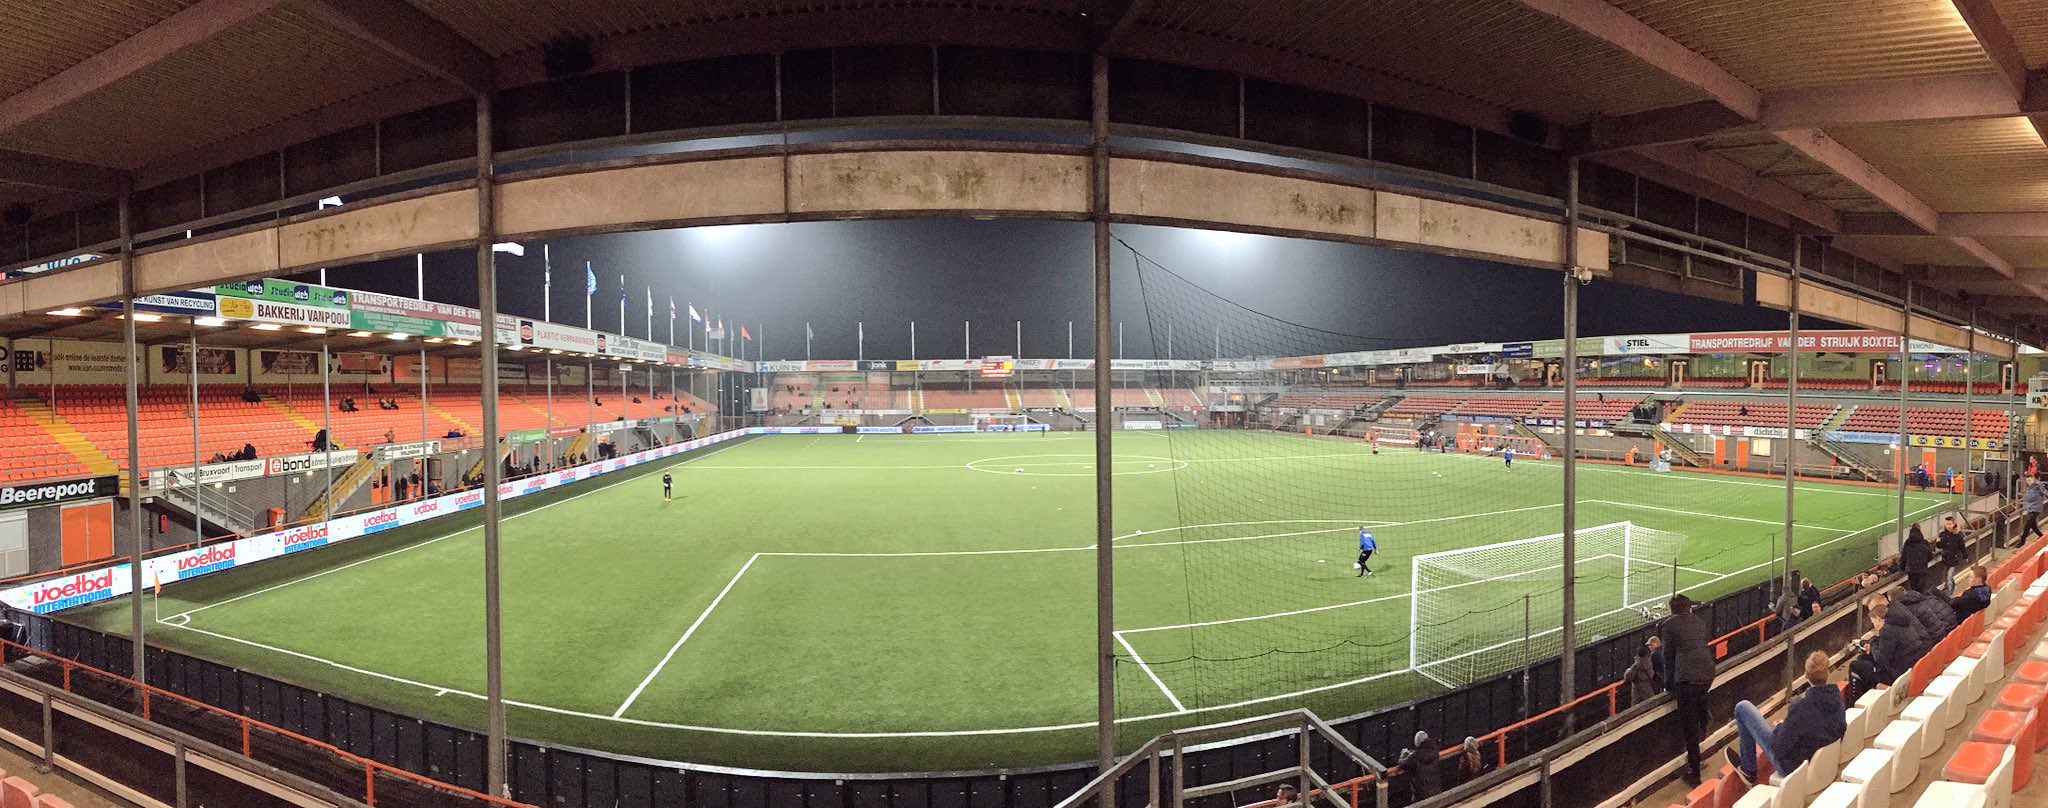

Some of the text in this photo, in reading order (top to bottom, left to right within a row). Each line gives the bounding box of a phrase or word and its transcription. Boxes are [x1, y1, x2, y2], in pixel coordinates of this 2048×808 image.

[144, 295, 165, 304] KUNST
[166, 297, 180, 305] VAN
[180, 298, 214, 309] RECYCLING
[351, 292, 434, 312] TRANSPORTBEDRIJF
[437, 304, 452, 315] VAN
[453, 308, 467, 318] DER
[257, 304, 305, 321] BAKKERIJ
[307, 309, 350, 325] VANPOOIJ
[1626, 339, 1649, 347] STIEL
[1691, 337, 1773, 349] TRANSPORTBEDRIJF
[1797, 337, 1816, 347] DER
[1820, 336, 1860, 348] STRUIJK
[1862, 336, 1899, 348] BOXTEL
[199, 467, 230, 477] Bruxvoort
[234, 463, 262, 473] Transport
[282, 455, 311, 471] bond
[0, 479, 95, 504] Beerepoot
[364, 508, 397, 527] voetbal
[284, 522, 329, 546] voetbal
[178, 541, 236, 571] voetbal
[178, 558, 236, 580] INTERNATIONAL
[33, 567, 113, 605] voetbal
[33, 587, 113, 615] INTERNATIONAL
